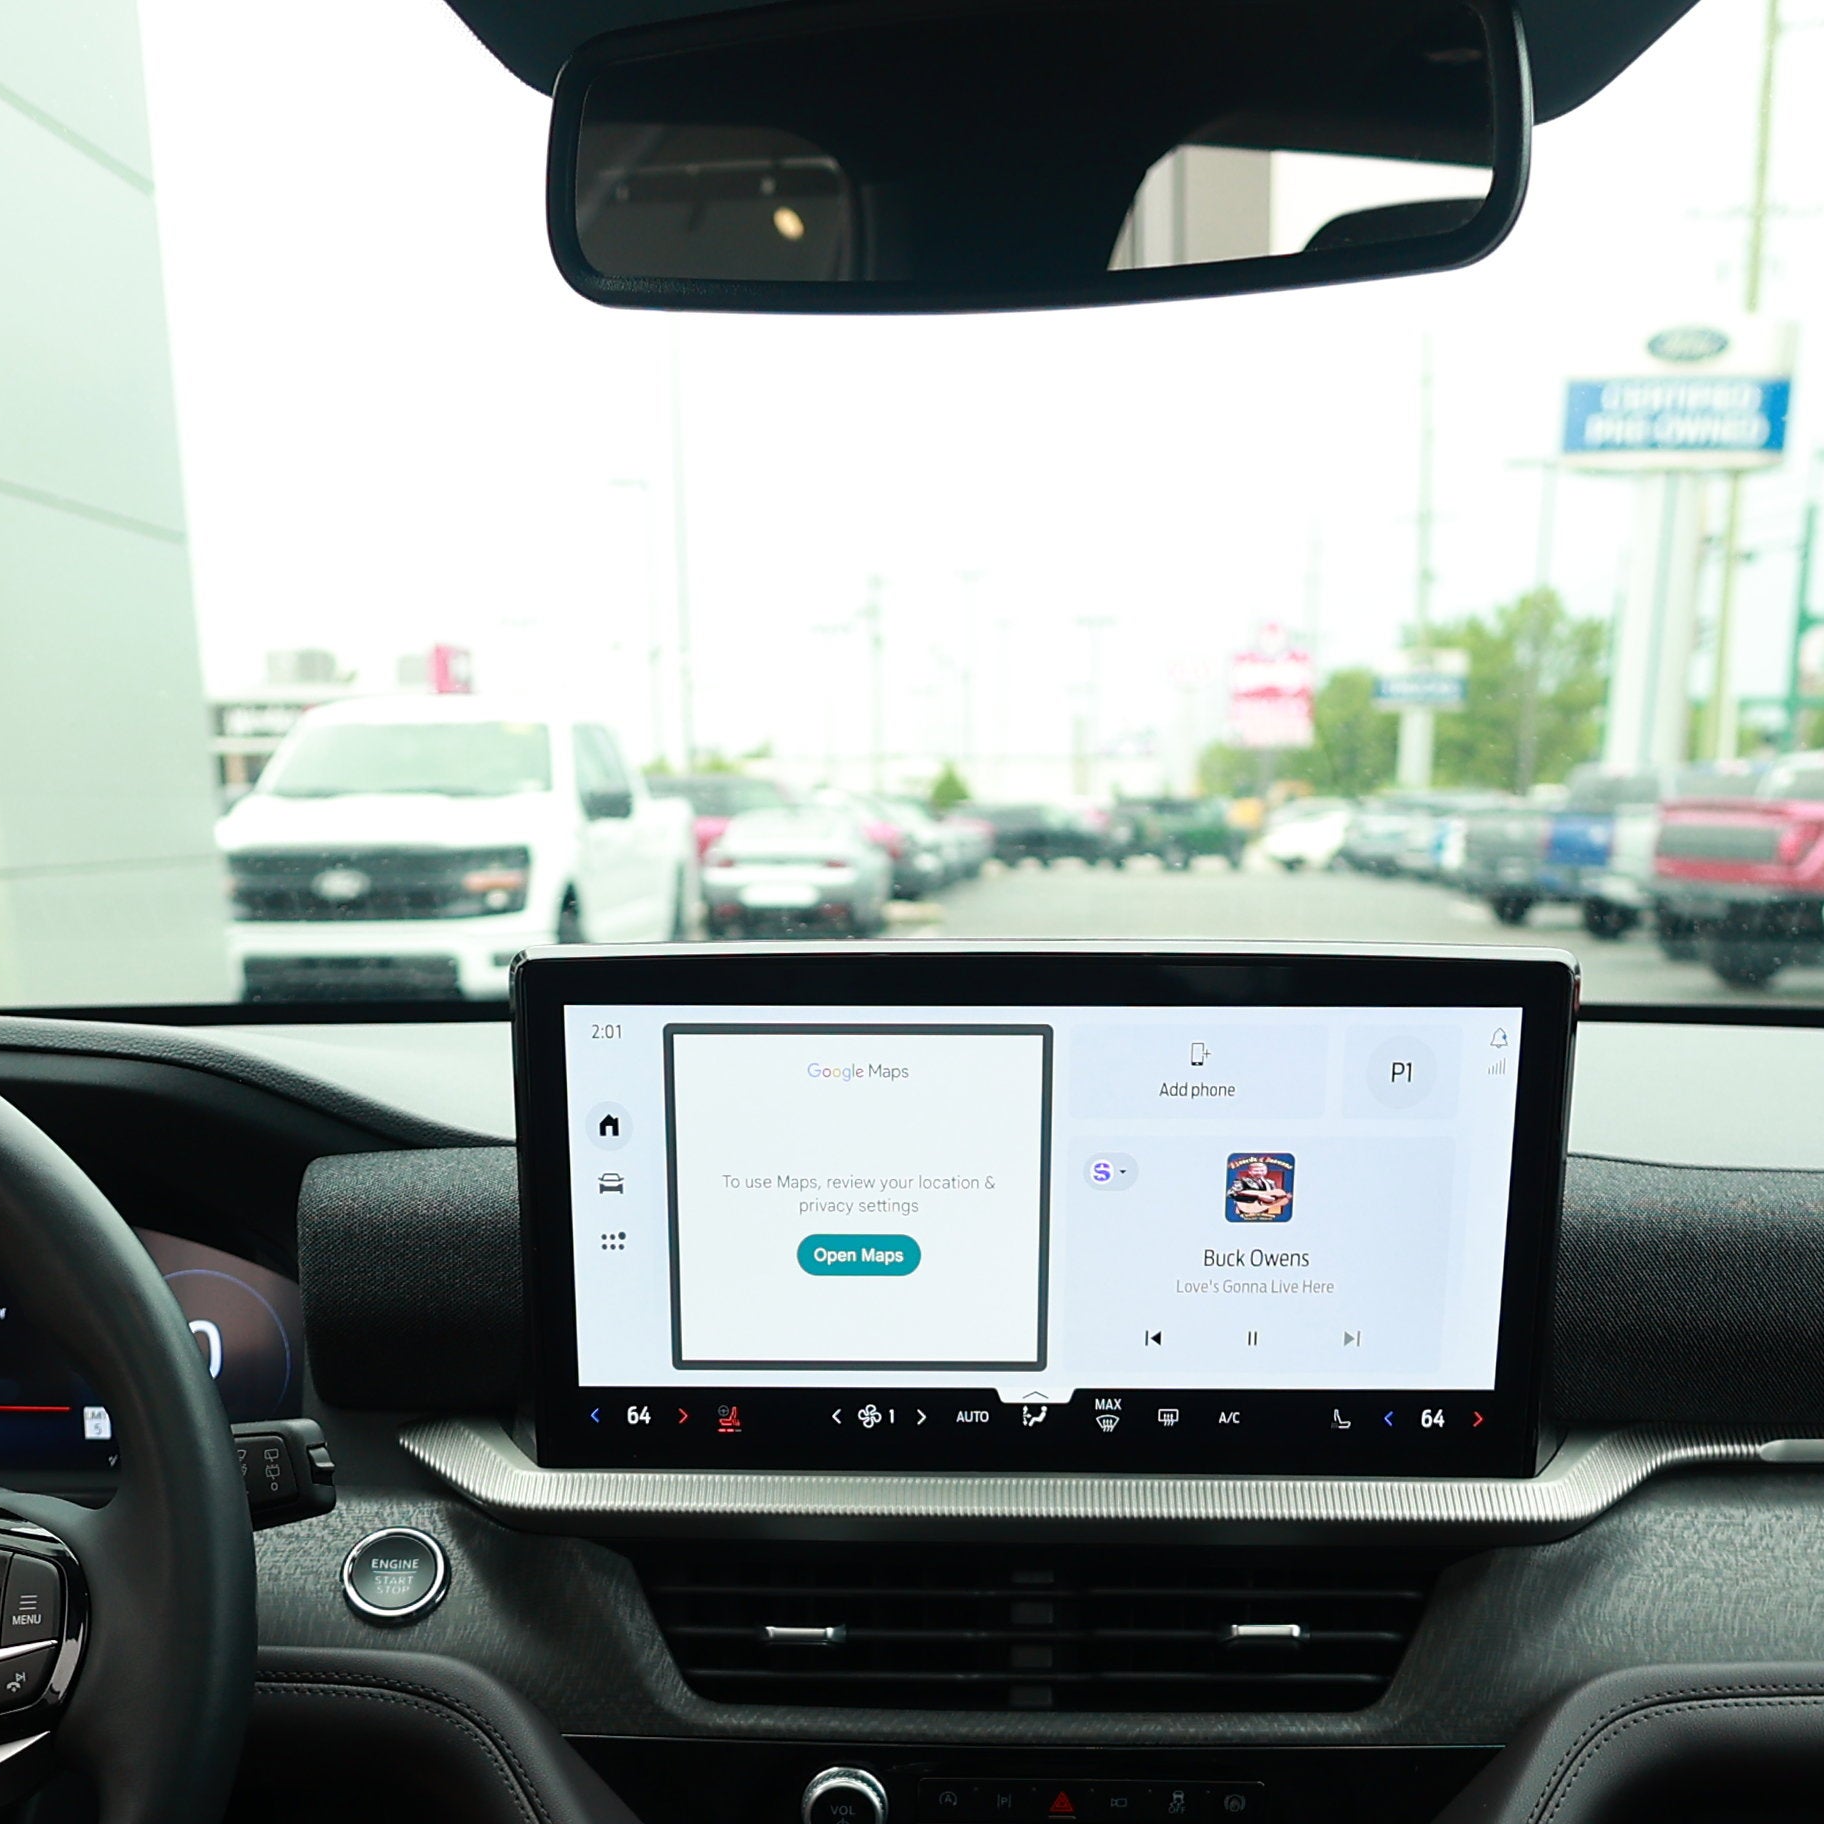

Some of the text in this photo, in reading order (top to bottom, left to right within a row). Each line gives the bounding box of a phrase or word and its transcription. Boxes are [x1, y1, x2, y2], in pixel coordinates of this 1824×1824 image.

[591, 1024, 623, 1040] 2:01
[807, 1062, 909, 1082] Google Maps
[1390, 1062, 1413, 1083] P1
[1159, 1083, 1236, 1100] Add phone
[723, 1174, 997, 1193] To use Maps, review your location &
[798, 1199, 920, 1216] privacy settings
[813, 1248, 905, 1267] Open Maps
[1203, 1249, 1310, 1268] Buck Owens
[1176, 1279, 1335, 1295] Love's Gonna Live Here
[1095, 1398, 1122, 1411] MAX
[627, 1406, 651, 1425] 64
[956, 1410, 989, 1424] AUTO
[1218, 1411, 1240, 1425] A/C
[1420, 1409, 1445, 1428] 64
[371, 1558, 420, 1569] ENGINE
[375, 1575, 414, 1585] START
[376, 1585, 411, 1595] STOP
[12, 1613, 43, 1626] MENU
[830, 1805, 856, 1816] VOL
